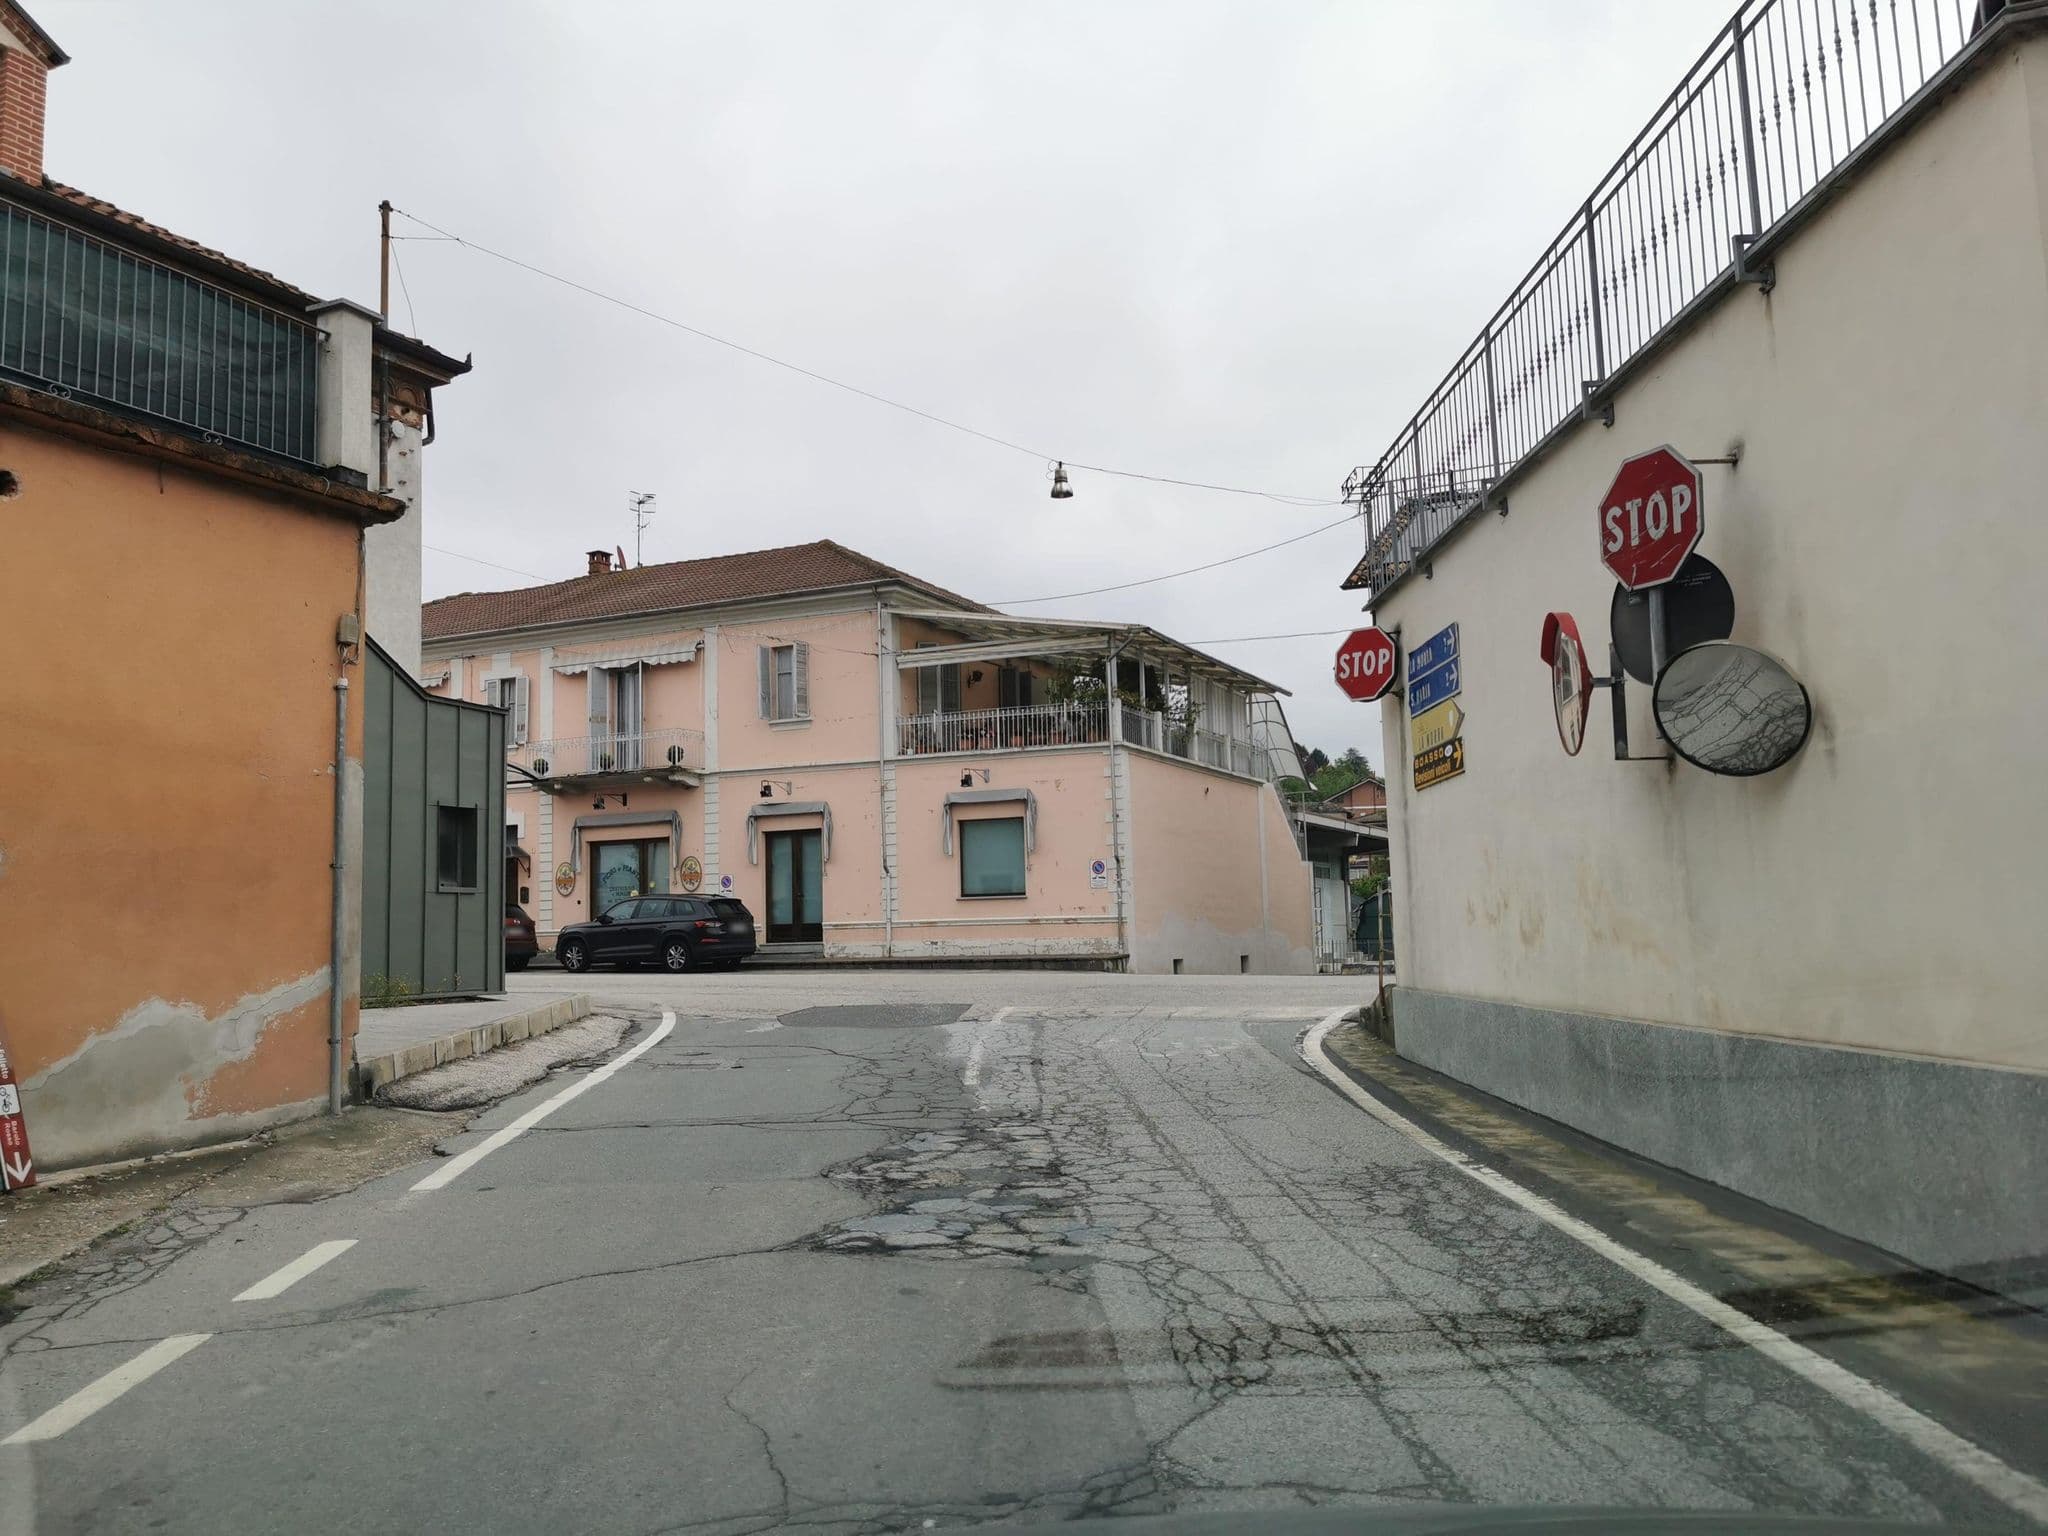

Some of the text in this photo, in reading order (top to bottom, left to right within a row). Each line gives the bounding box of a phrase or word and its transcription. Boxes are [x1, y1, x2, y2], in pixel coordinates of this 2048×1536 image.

[1606, 484, 1691, 553] STOP
[1340, 648, 1390, 679] STOP
[1415, 747, 1443, 769] BOASSO
[11, 1120, 20, 1146] Barolo
